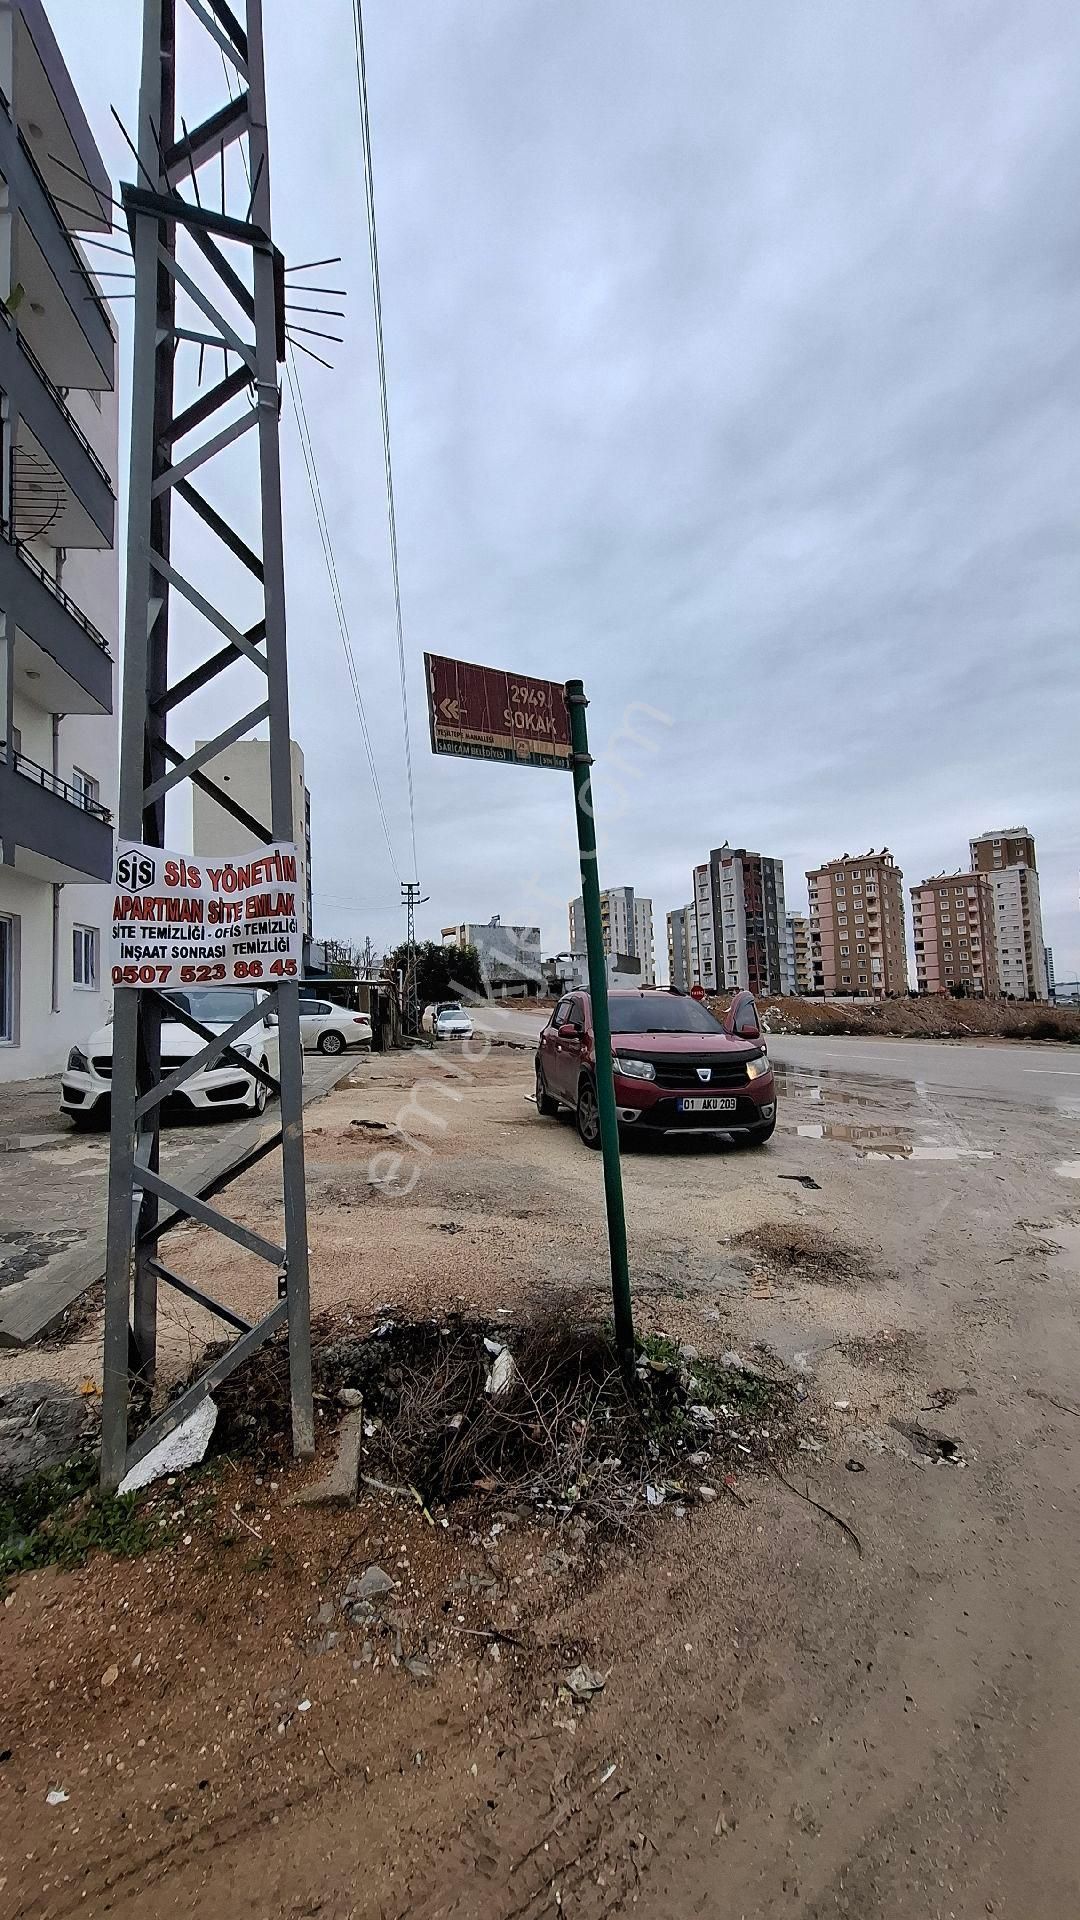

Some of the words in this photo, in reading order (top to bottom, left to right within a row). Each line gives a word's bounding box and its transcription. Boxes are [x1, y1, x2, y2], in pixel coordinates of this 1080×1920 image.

[511, 685, 546, 707] 2949
[503, 709, 557, 734] SOKAK
[164, 859, 201, 889] SİS
[206, 850, 297, 893] YÖNETİM
[112, 895, 204, 923] APARTMAN
[207, 897, 243, 925] SİTE
[245, 893, 296, 919] EMLAK
[112, 923, 136, 940] SİTE
[140, 923, 205, 941] TEMİZLİĞİ
[214, 924, 242, 939] OFİS
[243, 918, 298, 936] TEMİZLİĞİ
[120, 943, 168, 961] İNŞAAT
[171, 944, 226, 959] SONRASI
[232, 937, 290, 955] TEMİZLİĞİ
[112, 965, 172, 984] 0507
[180, 963, 227, 983] 523
[233, 960, 263, 977] 86
[269, 958, 297, 976] 45
[684, 1099, 695, 1110] 01
[702, 1099, 718, 1110] AKU
[720, 1098, 736, 1110] 209
